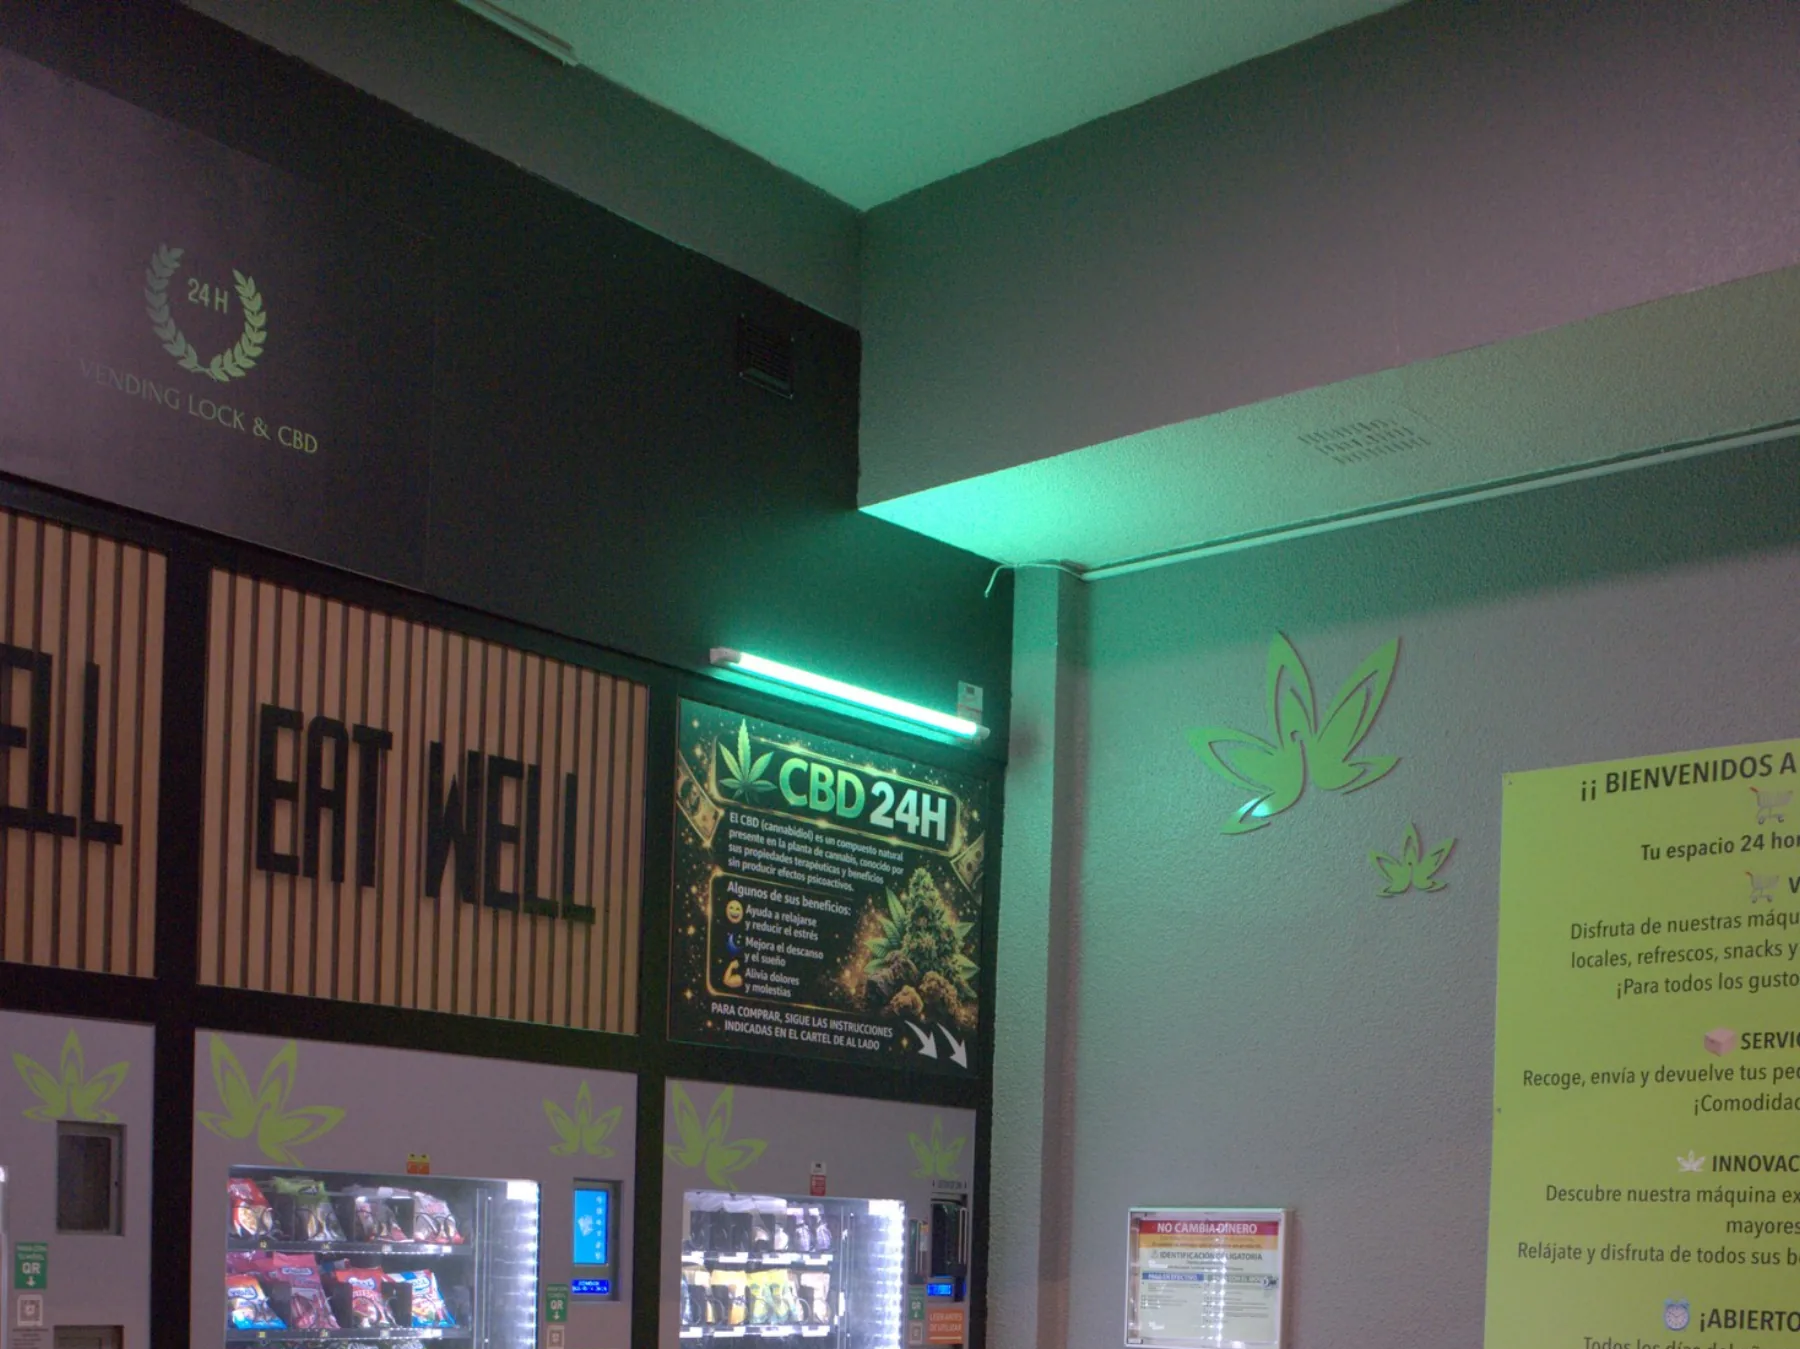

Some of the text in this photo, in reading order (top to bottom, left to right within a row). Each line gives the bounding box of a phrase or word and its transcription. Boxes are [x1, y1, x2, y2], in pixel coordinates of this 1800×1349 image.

[80, 358, 318, 453] VENDING LOCK & CBD
[1605, 754, 1773, 794] BIENVENIDOS
[1780, 752, 1797, 775] A
[779, 757, 946, 841] CBD 24H
[256, 704, 595, 925] EAT WELL
[729, 812, 903, 861] El CBD (cannabidiol) es un compuesto natural
[1641, 844, 1661, 861] Tu
[1666, 838, 1735, 861] espacio
[1740, 834, 1765, 852] 24
[728, 843, 884, 885] sus propiedades terapéuticas y beneficios
[729, 829, 904, 876] presente en la planta de cannabis, conocido por
[728, 857, 854, 892] sin producir efectos psicoactivos.
[727, 881, 851, 916] Algunos de sus beneficios:
[746, 905, 817, 928] Ayuda a relajarse
[1571, 919, 1635, 940] Disfruta
[1641, 917, 1661, 935] de
[1667, 914, 1742, 933] nuestras
[745, 920, 819, 941] y reducir el estrés
[744, 951, 786, 967] y el sueño
[745, 937, 824, 960] Mejora el descanso
[1571, 939, 1799, 969] locales, refrescos, snacks y
[745, 968, 799, 986] Alivia dolores
[745, 983, 791, 998] y molestias
[1617, 978, 1659, 1000] ¡Para
[1664, 974, 1713, 993] todos
[1719, 972, 1743, 990] los
[711, 1002, 893, 1038] PARA COMPRAR, SIGUE LAS INSTRUCCIONES
[724, 1020, 880, 1050] INDICADAS EN EL CARTEL DE AL LADO
[1523, 1070, 1586, 1090] Recoge,
[1590, 1068, 1636, 1086] envía
[1640, 1070, 1650, 1088] y
[1654, 1064, 1735, 1083] devuelve
[1740, 1064, 1767, 1082] tus
[1546, 1184, 1621, 1203] Descubre
[1627, 1187, 1691, 1203] nuestra
[1697, 1185, 1776, 1208] máquina
[1157, 1223, 1172, 1233] NO
[1174, 1223, 1215, 1233] CAMBIA
[1518, 1242, 1582, 1264] Relájate
[1586, 1248, 1596, 1265] y
[1600, 1242, 1665, 1263] disfruta
[1670, 1245, 1691, 1263] de
[1697, 1246, 1745, 1264] todos
[1751, 1251, 1780, 1265] sus
[22, 1262, 41, 1274] QR
